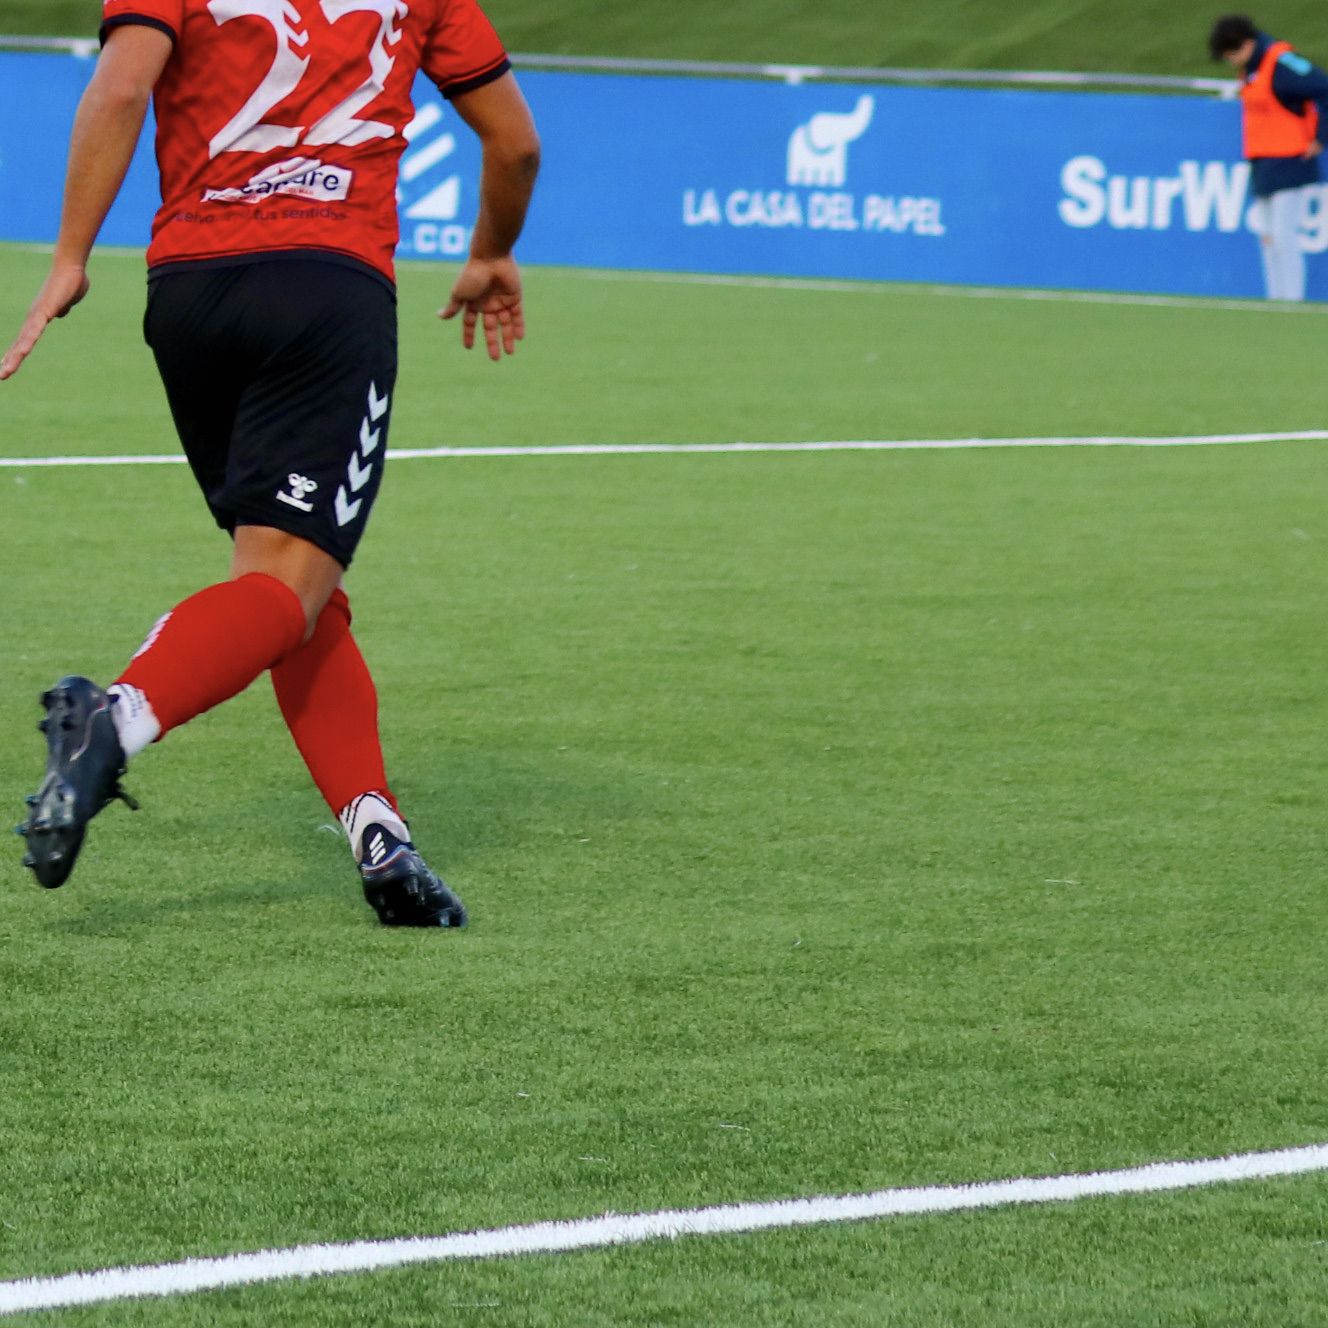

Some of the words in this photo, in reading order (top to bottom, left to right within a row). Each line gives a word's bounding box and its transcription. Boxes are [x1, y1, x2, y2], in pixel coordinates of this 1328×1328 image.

[683, 188, 722, 227] LA
[725, 188, 804, 229] CASA
[807, 191, 860, 231] DEL
[862, 193, 947, 237] PAPEL
